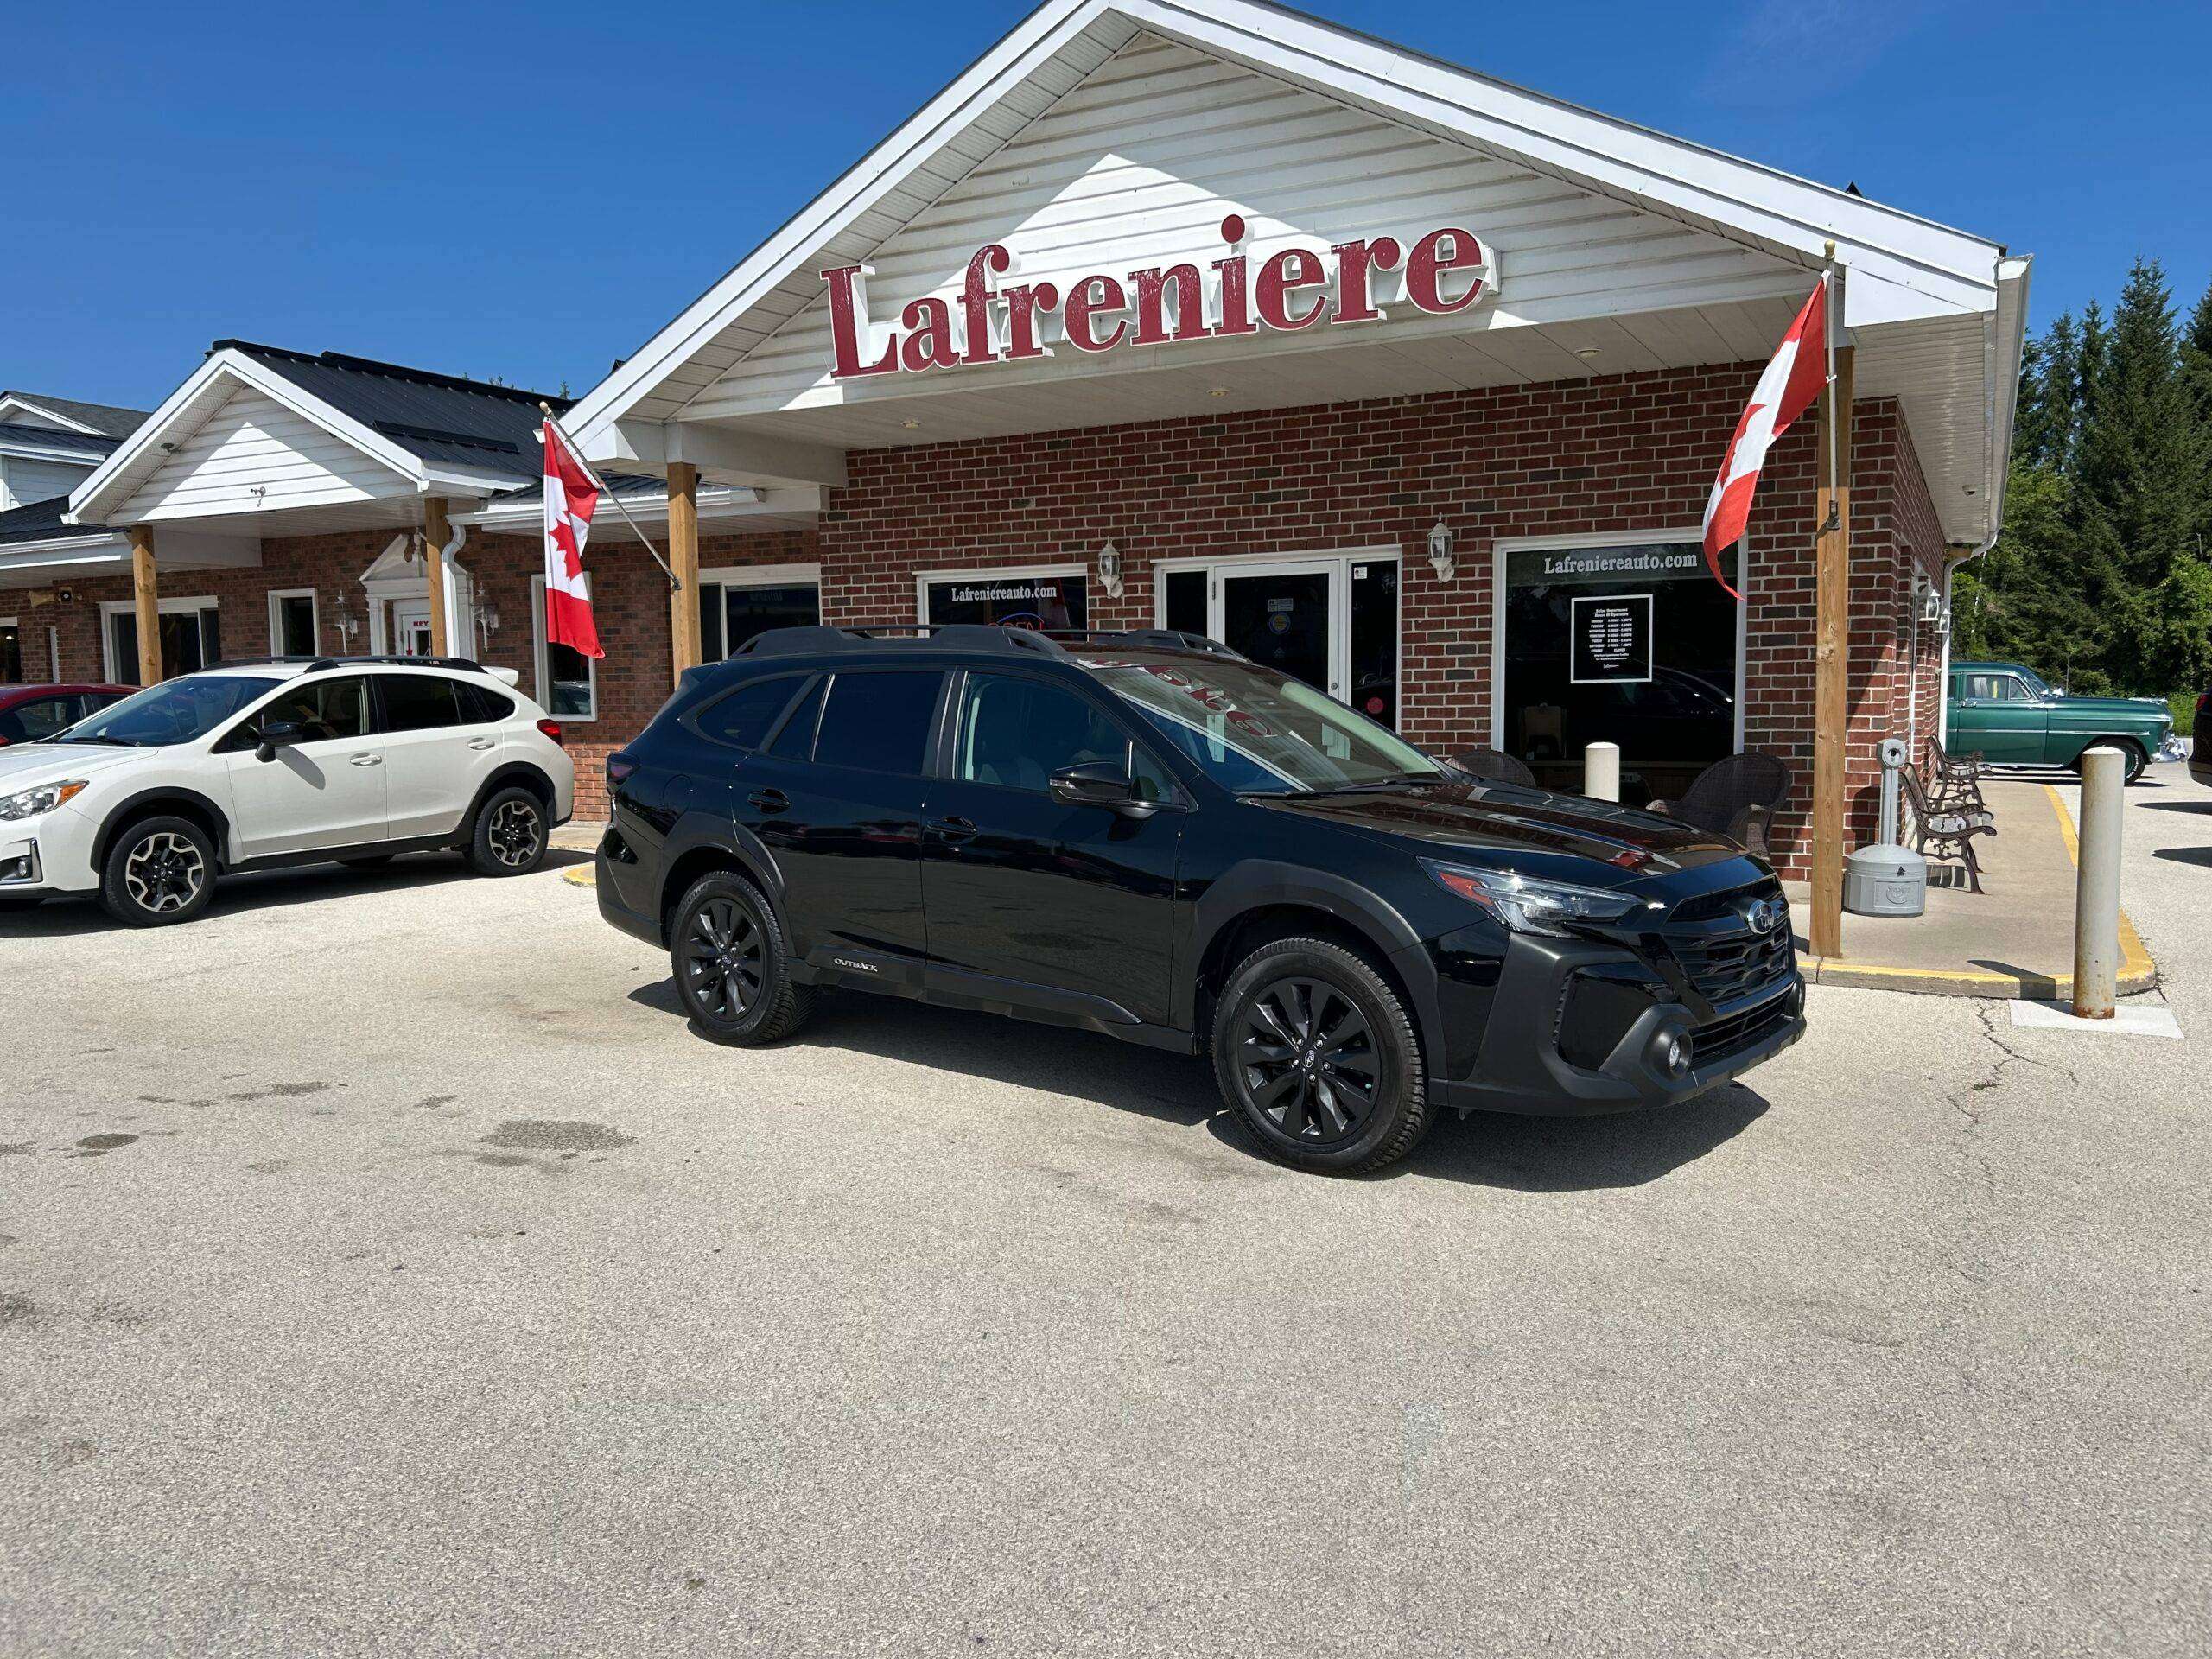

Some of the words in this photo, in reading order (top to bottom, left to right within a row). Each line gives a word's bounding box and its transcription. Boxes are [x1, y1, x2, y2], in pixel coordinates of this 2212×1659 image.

[820, 213, 1488, 378] Lafreniere
[1543, 554, 1698, 574] Lafreniereauto.com
[951, 586, 1057, 601] Lafreniereauto.com
[834, 958, 878, 972] OUTBACK
